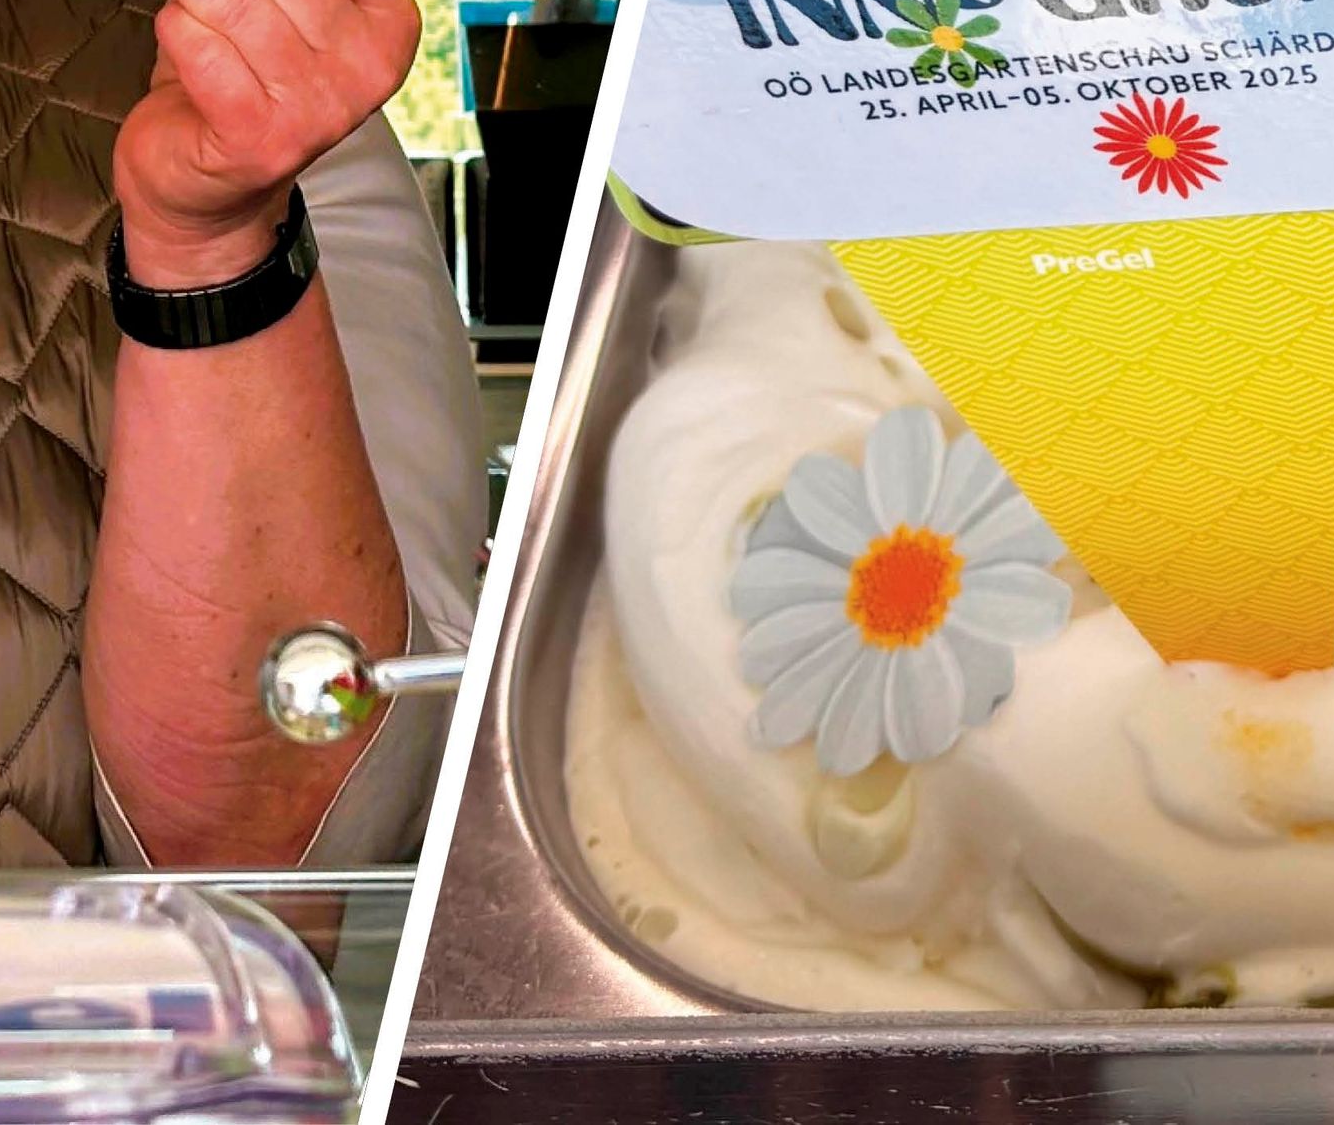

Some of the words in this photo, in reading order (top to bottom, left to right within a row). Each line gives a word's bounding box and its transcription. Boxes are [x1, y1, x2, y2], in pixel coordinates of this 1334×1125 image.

[764, 71, 812, 98] OÖ
[821, 43, 1190, 94] LANDESGARTENSCHAU
[860, 99, 907, 120] 25.
[1077, 71, 1229, 102] OKTOBER
[1240, 64, 1317, 89] 2025
[1031, 247, 1156, 276] PreGel
